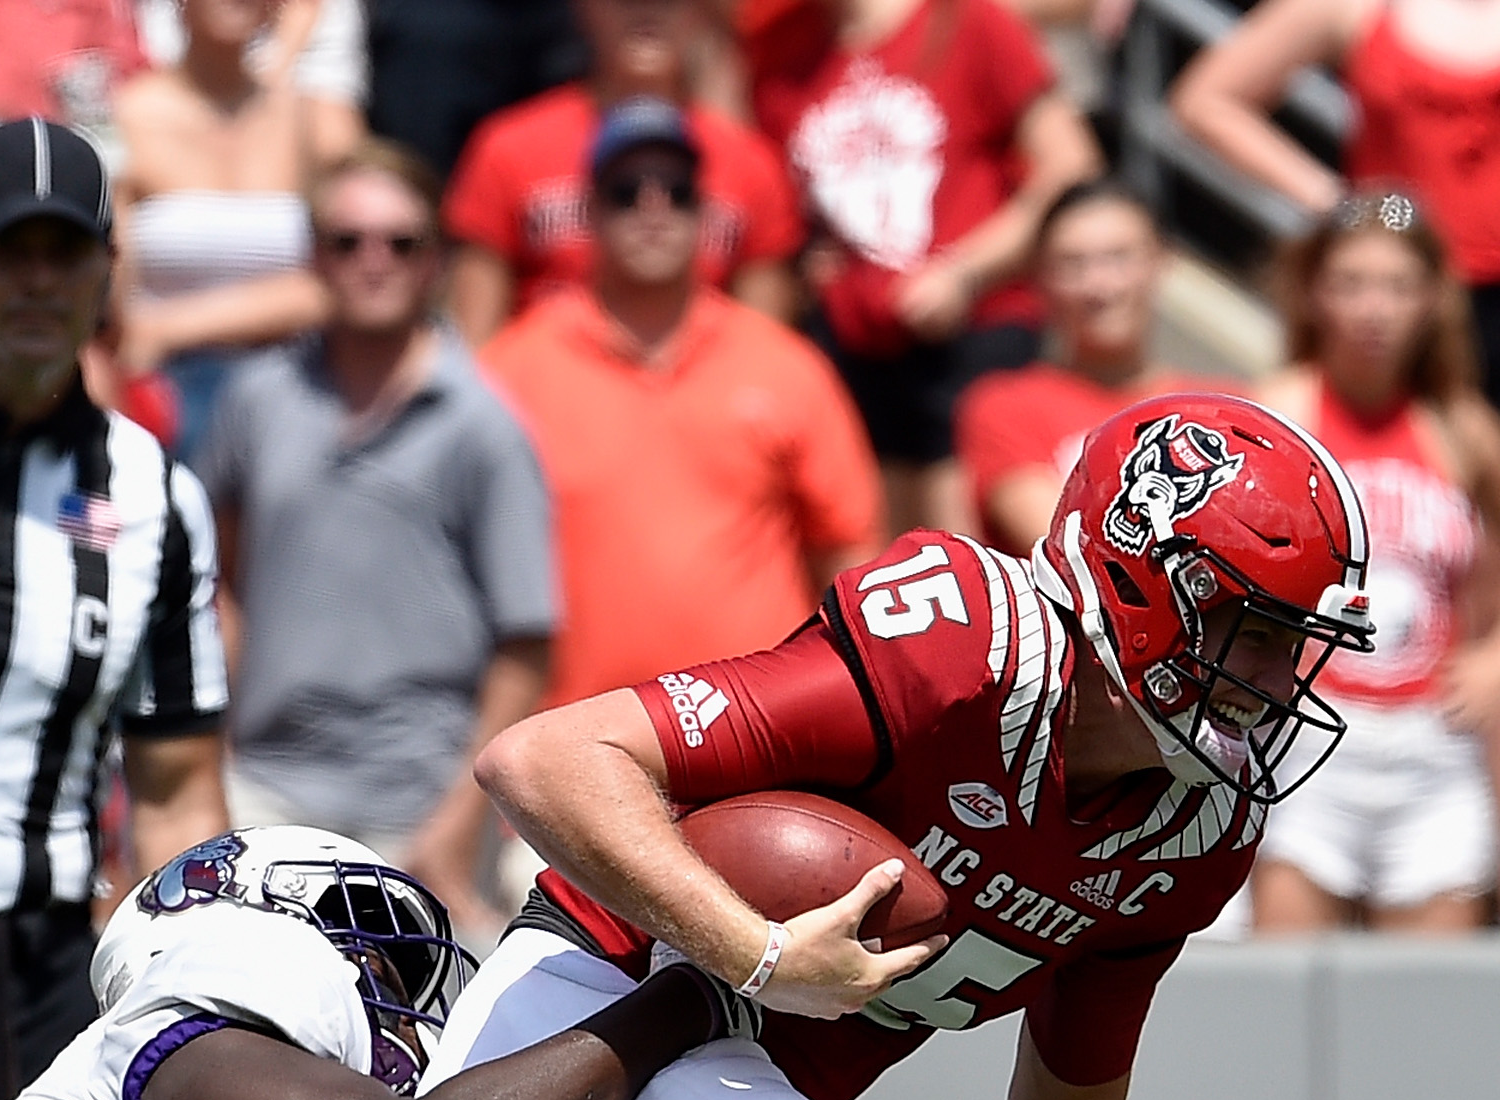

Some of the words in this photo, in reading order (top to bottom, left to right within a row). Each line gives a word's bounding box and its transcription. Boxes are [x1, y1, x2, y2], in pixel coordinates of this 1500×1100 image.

[857, 545, 970, 640] 15
[71, 594, 109, 659] C
[657, 673, 705, 748] adidas
[956, 791, 1004, 822] ACC
[909, 825, 982, 887] NC
[974, 872, 1097, 946] STATE
[1068, 878, 1116, 911] adidas
[1116, 871, 1175, 916] C
